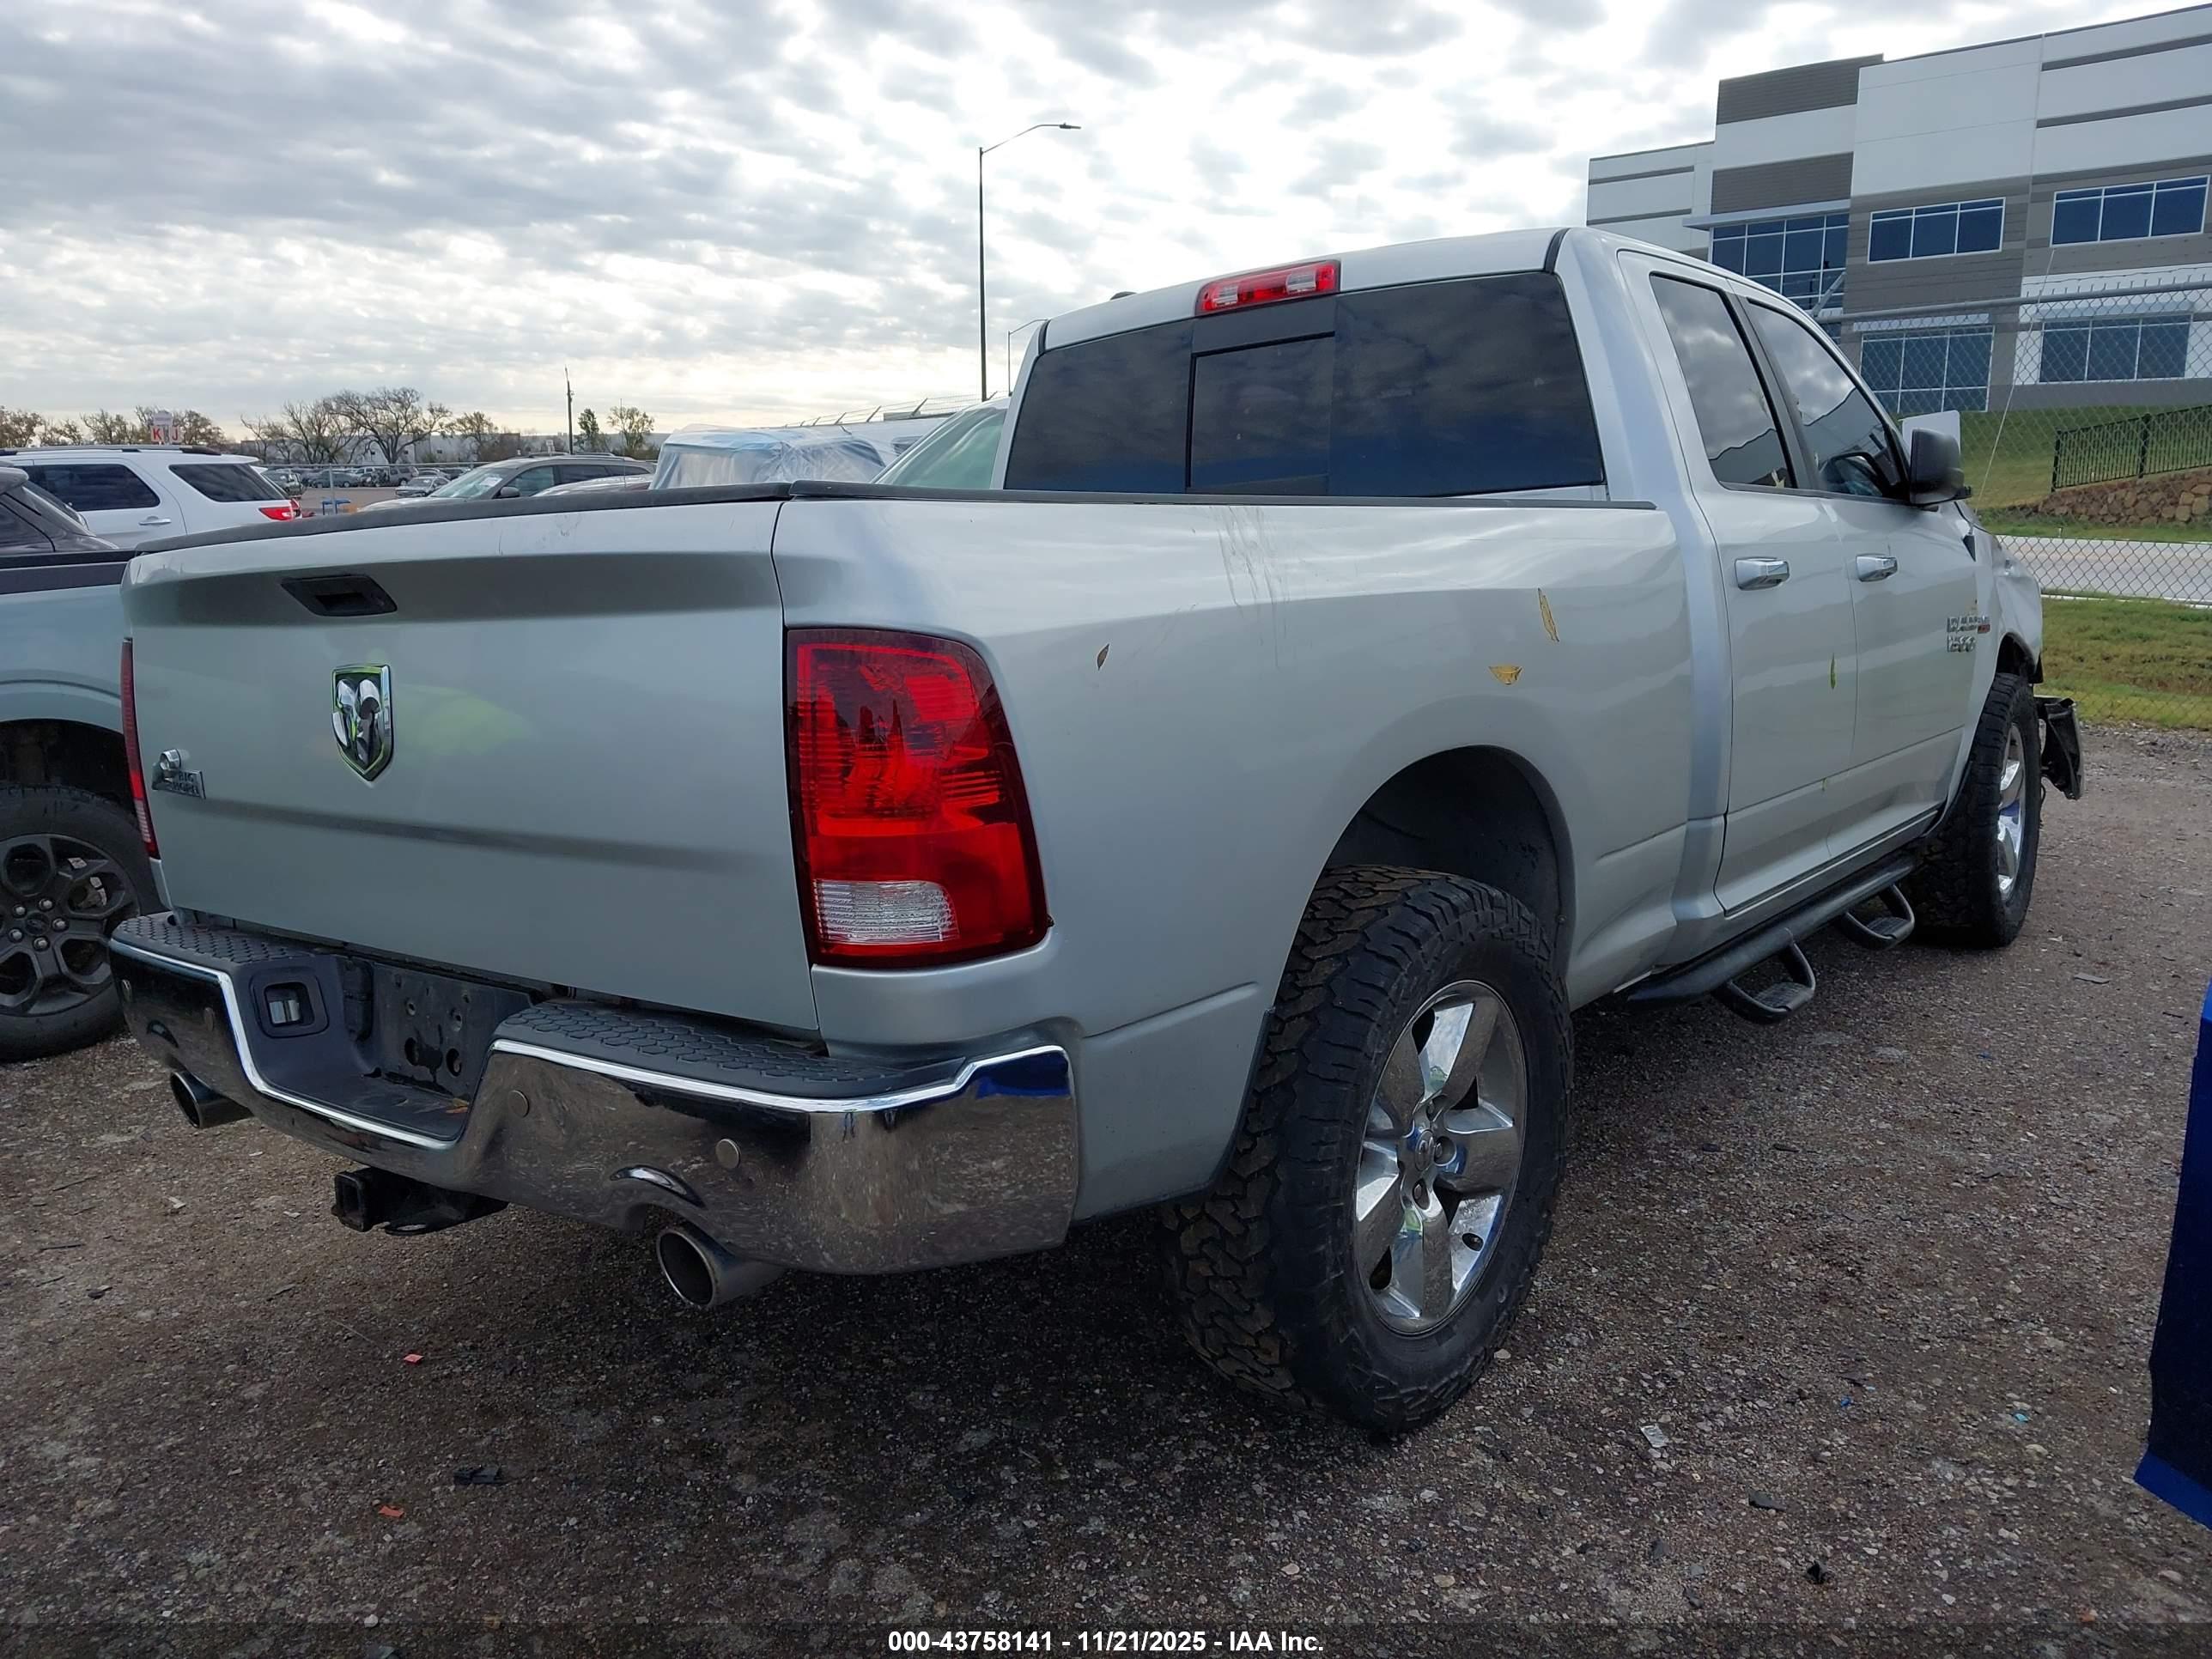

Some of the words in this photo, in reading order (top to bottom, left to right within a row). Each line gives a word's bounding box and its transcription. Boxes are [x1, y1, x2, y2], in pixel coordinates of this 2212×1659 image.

[153, 428, 162, 441] K
[179, 770, 195, 782] BIG
[173, 781, 200, 795] HORN
